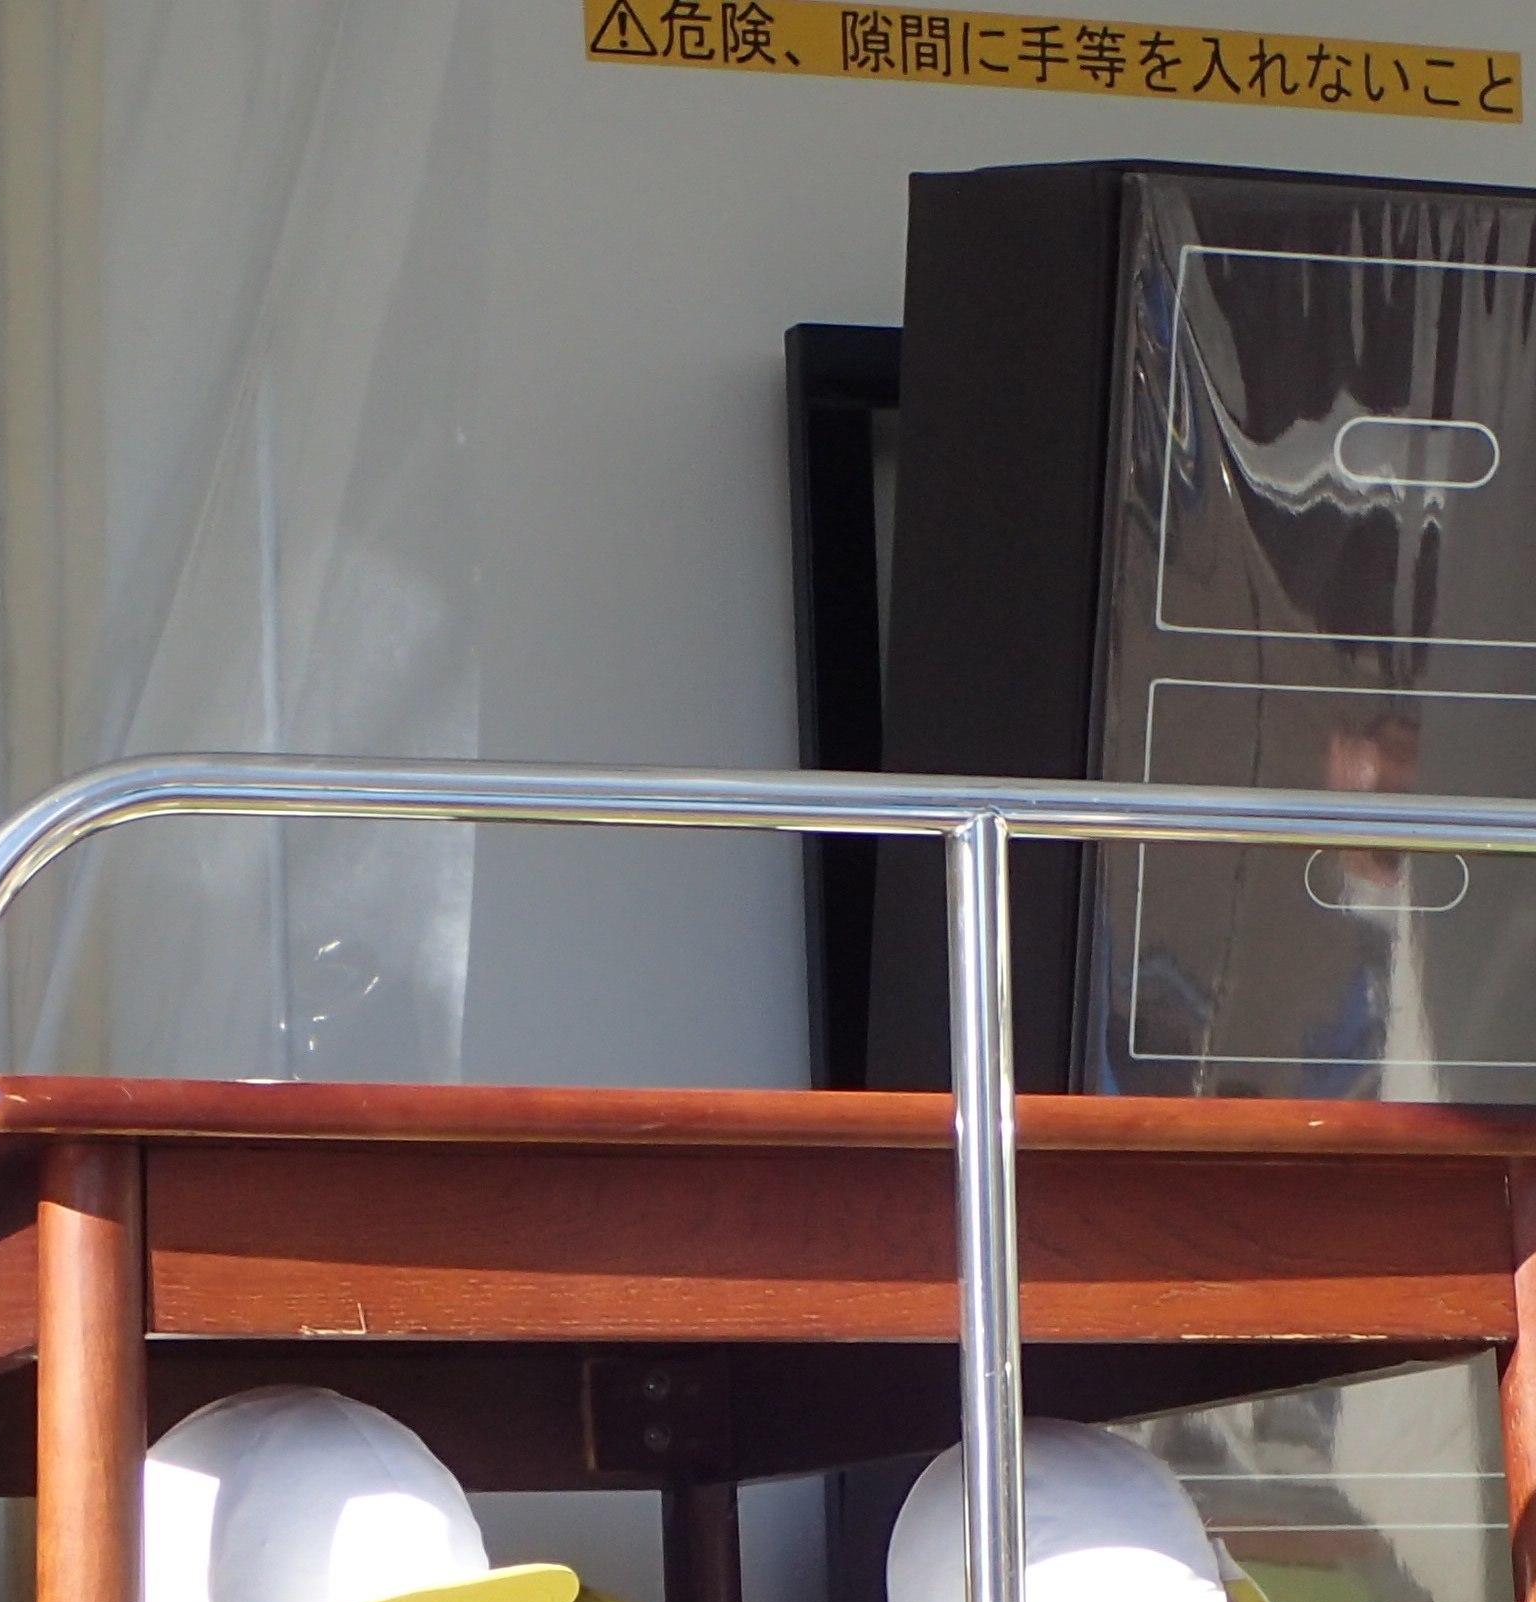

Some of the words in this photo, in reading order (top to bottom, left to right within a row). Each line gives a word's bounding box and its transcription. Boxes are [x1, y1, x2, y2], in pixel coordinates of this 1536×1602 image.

[660, 0, 1513, 114] 危険、隙間に手等を入れないこと
